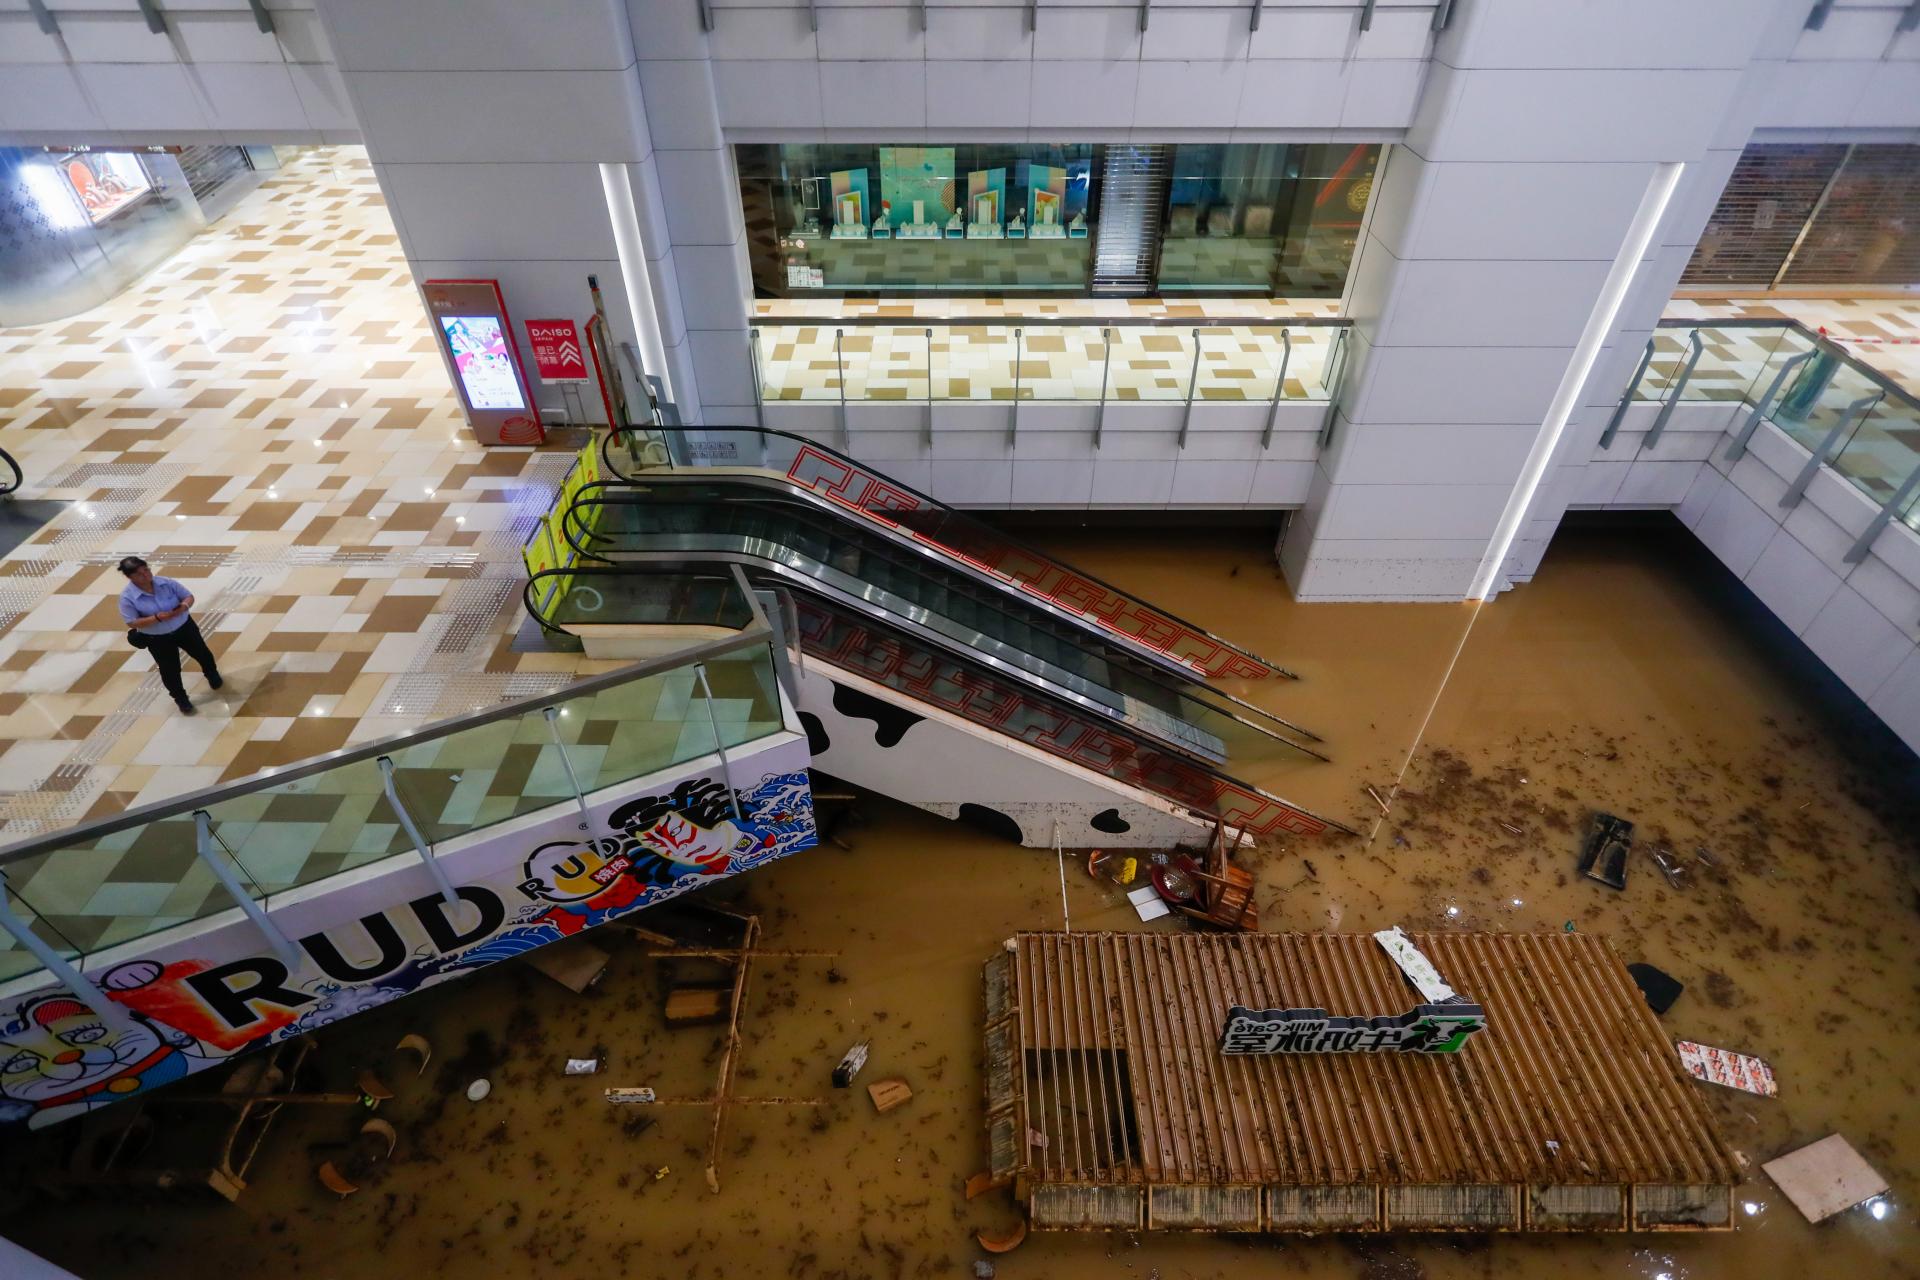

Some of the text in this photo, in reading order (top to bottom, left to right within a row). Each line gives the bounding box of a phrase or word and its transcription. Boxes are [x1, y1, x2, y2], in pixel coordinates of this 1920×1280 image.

[531, 328, 572, 337] DAISO
[516, 838, 621, 900] RUD
[185, 886, 505, 1028] RUD
